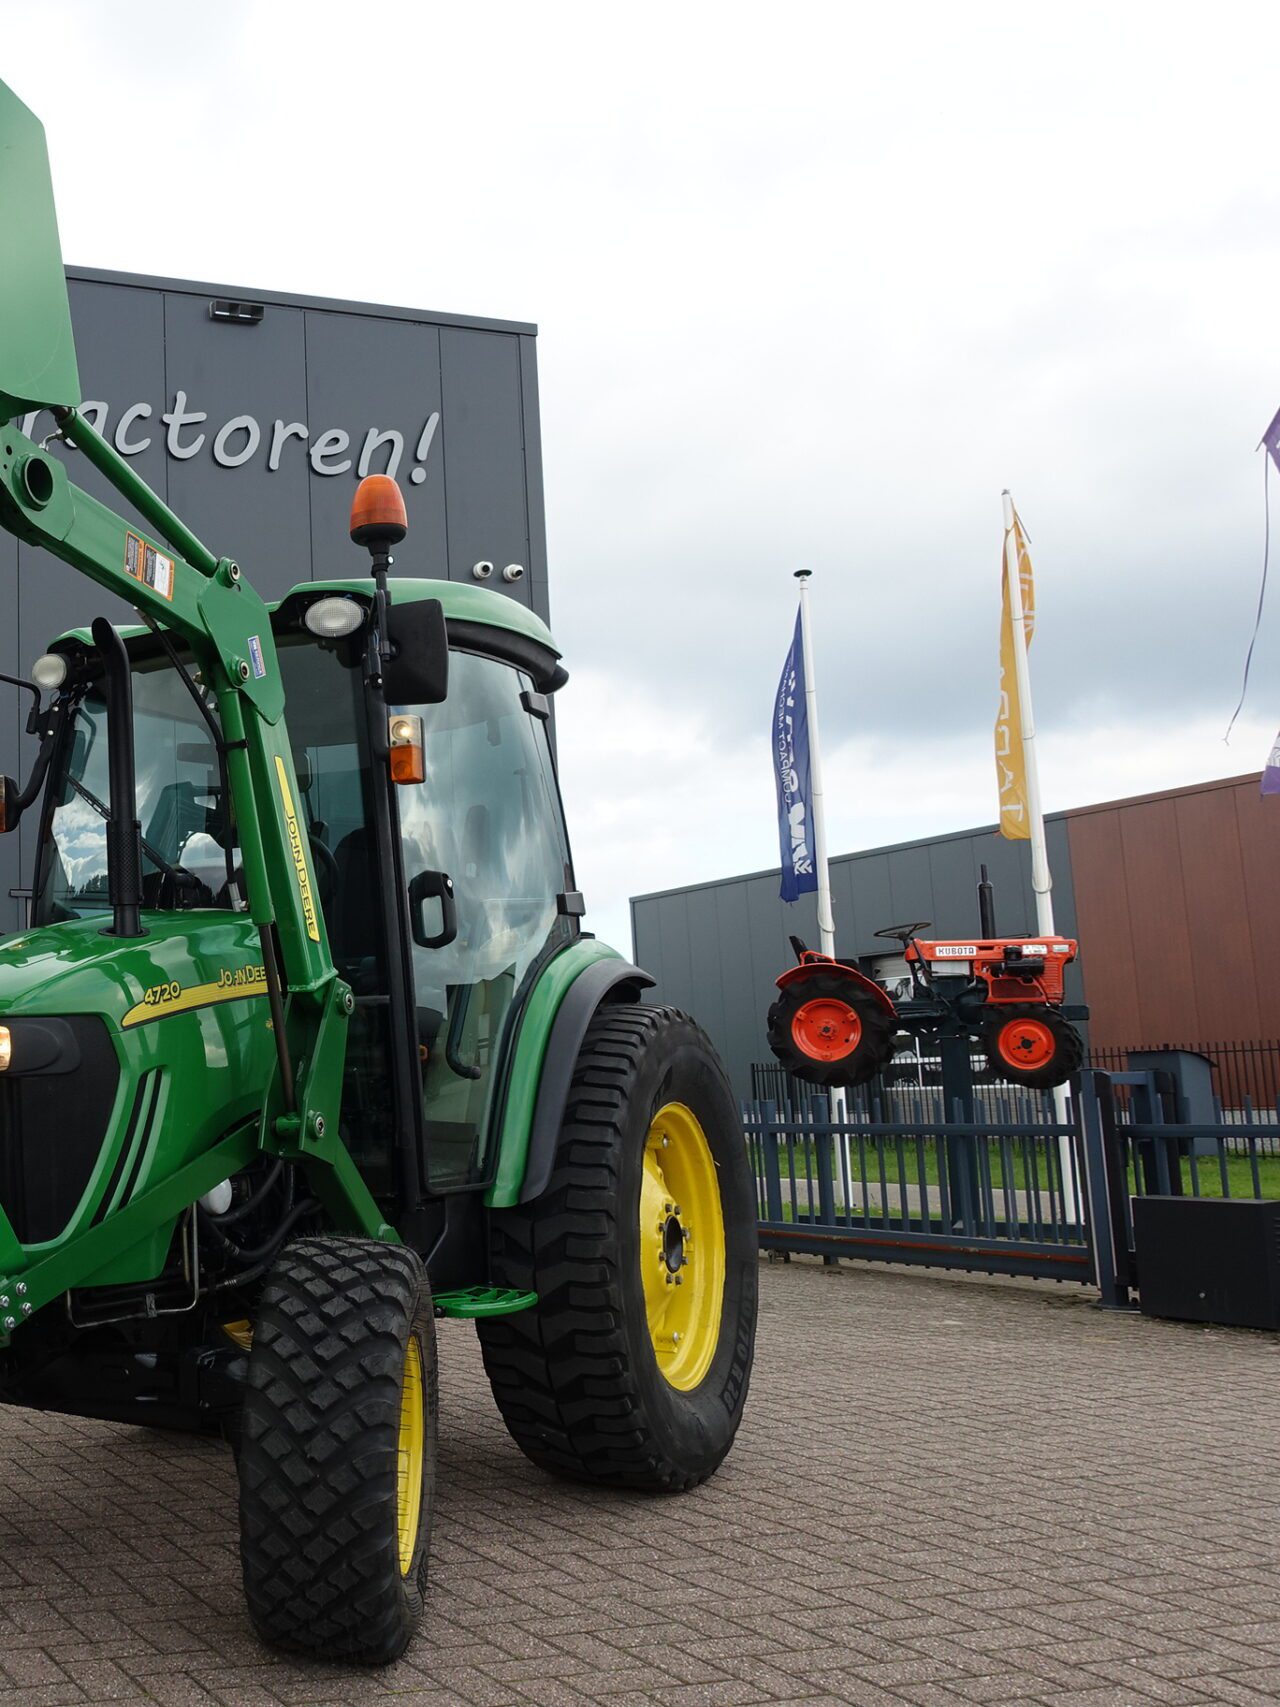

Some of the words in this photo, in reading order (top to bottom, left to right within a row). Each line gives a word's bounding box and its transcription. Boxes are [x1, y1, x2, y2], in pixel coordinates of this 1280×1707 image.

[285, 809, 303, 863] JOHN
[297, 867, 317, 933] DEERE
[938, 947, 975, 955] KUBOTA
[245, 964, 267, 983] DEE
[144, 981, 181, 1004] 4720
